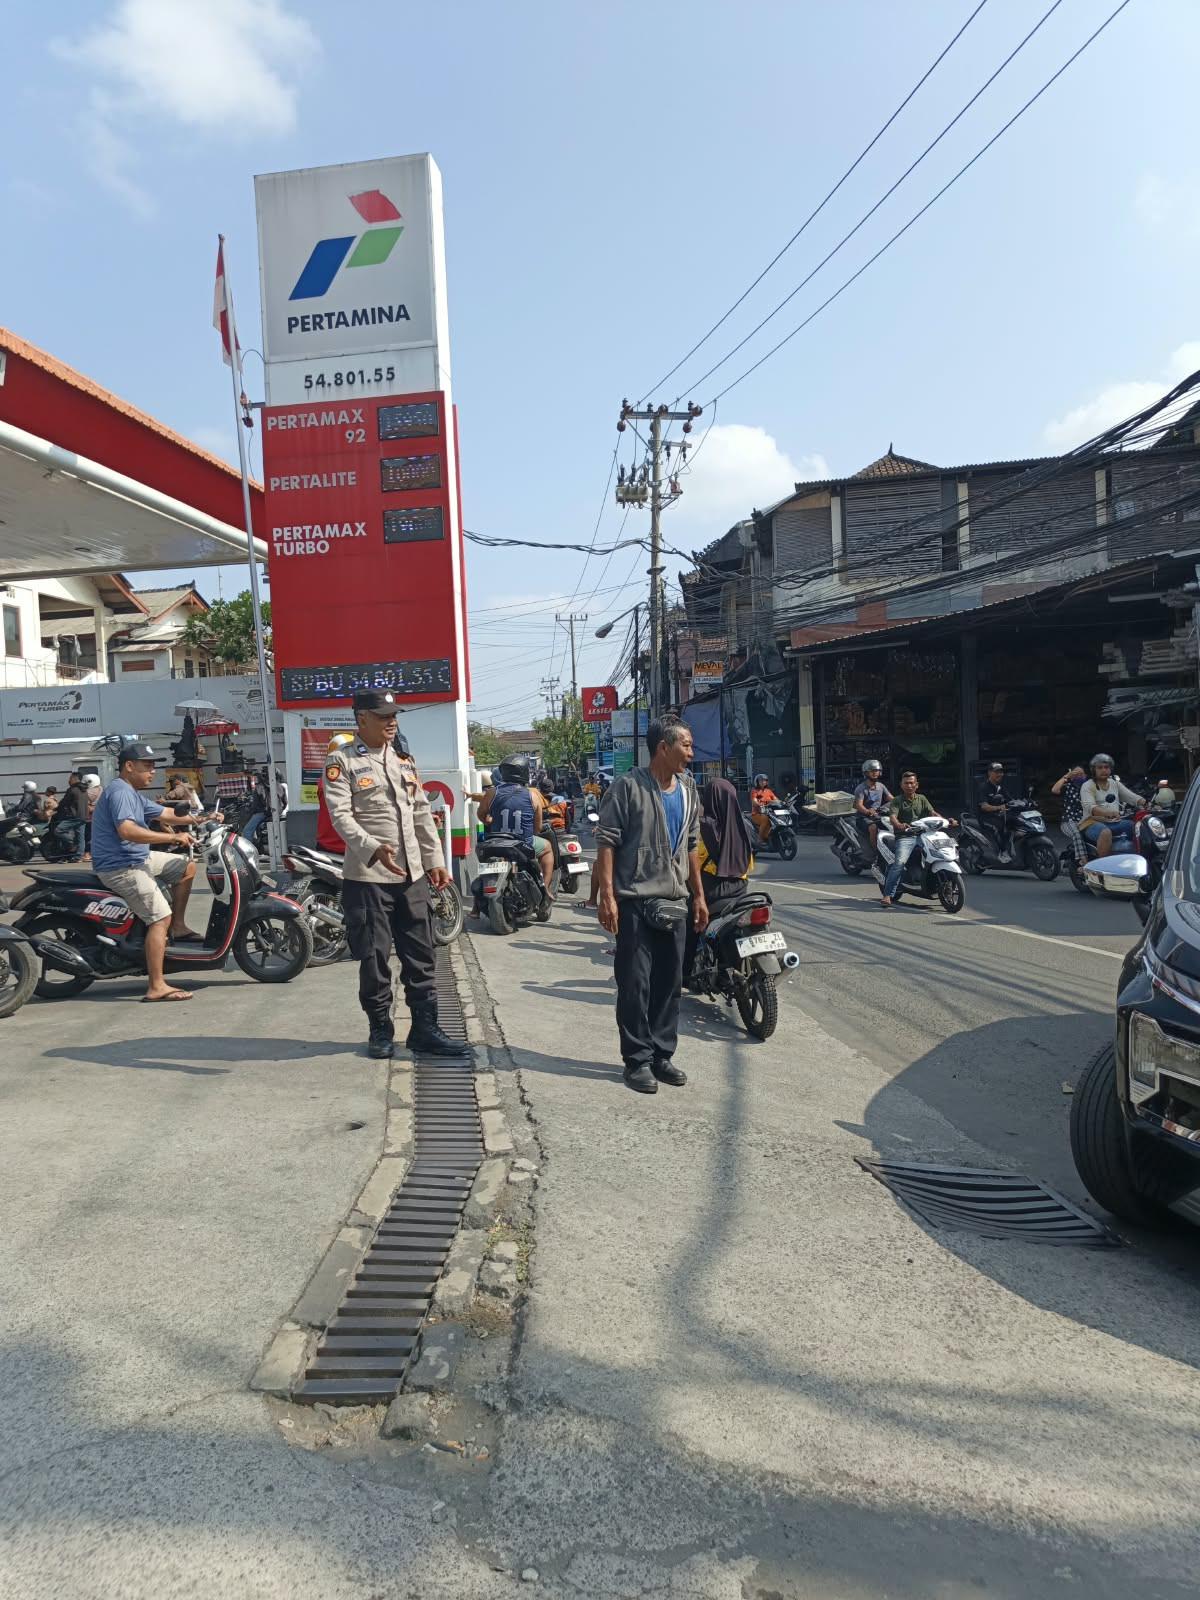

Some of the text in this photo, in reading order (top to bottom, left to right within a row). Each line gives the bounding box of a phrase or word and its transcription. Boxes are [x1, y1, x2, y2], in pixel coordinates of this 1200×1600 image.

[287, 304, 411, 334] PERTAMINA
[303, 366, 396, 389] 54.801.55
[267, 408, 364, 431] PERTAMAX
[345, 429, 366, 444] 92
[269, 471, 357, 491] PERTALITE
[272, 522, 367, 542] PERTAMAX
[274, 540, 330, 557] TURBO
[500, 808, 524, 835] 11
[84, 901, 132, 921] SCOOPY
